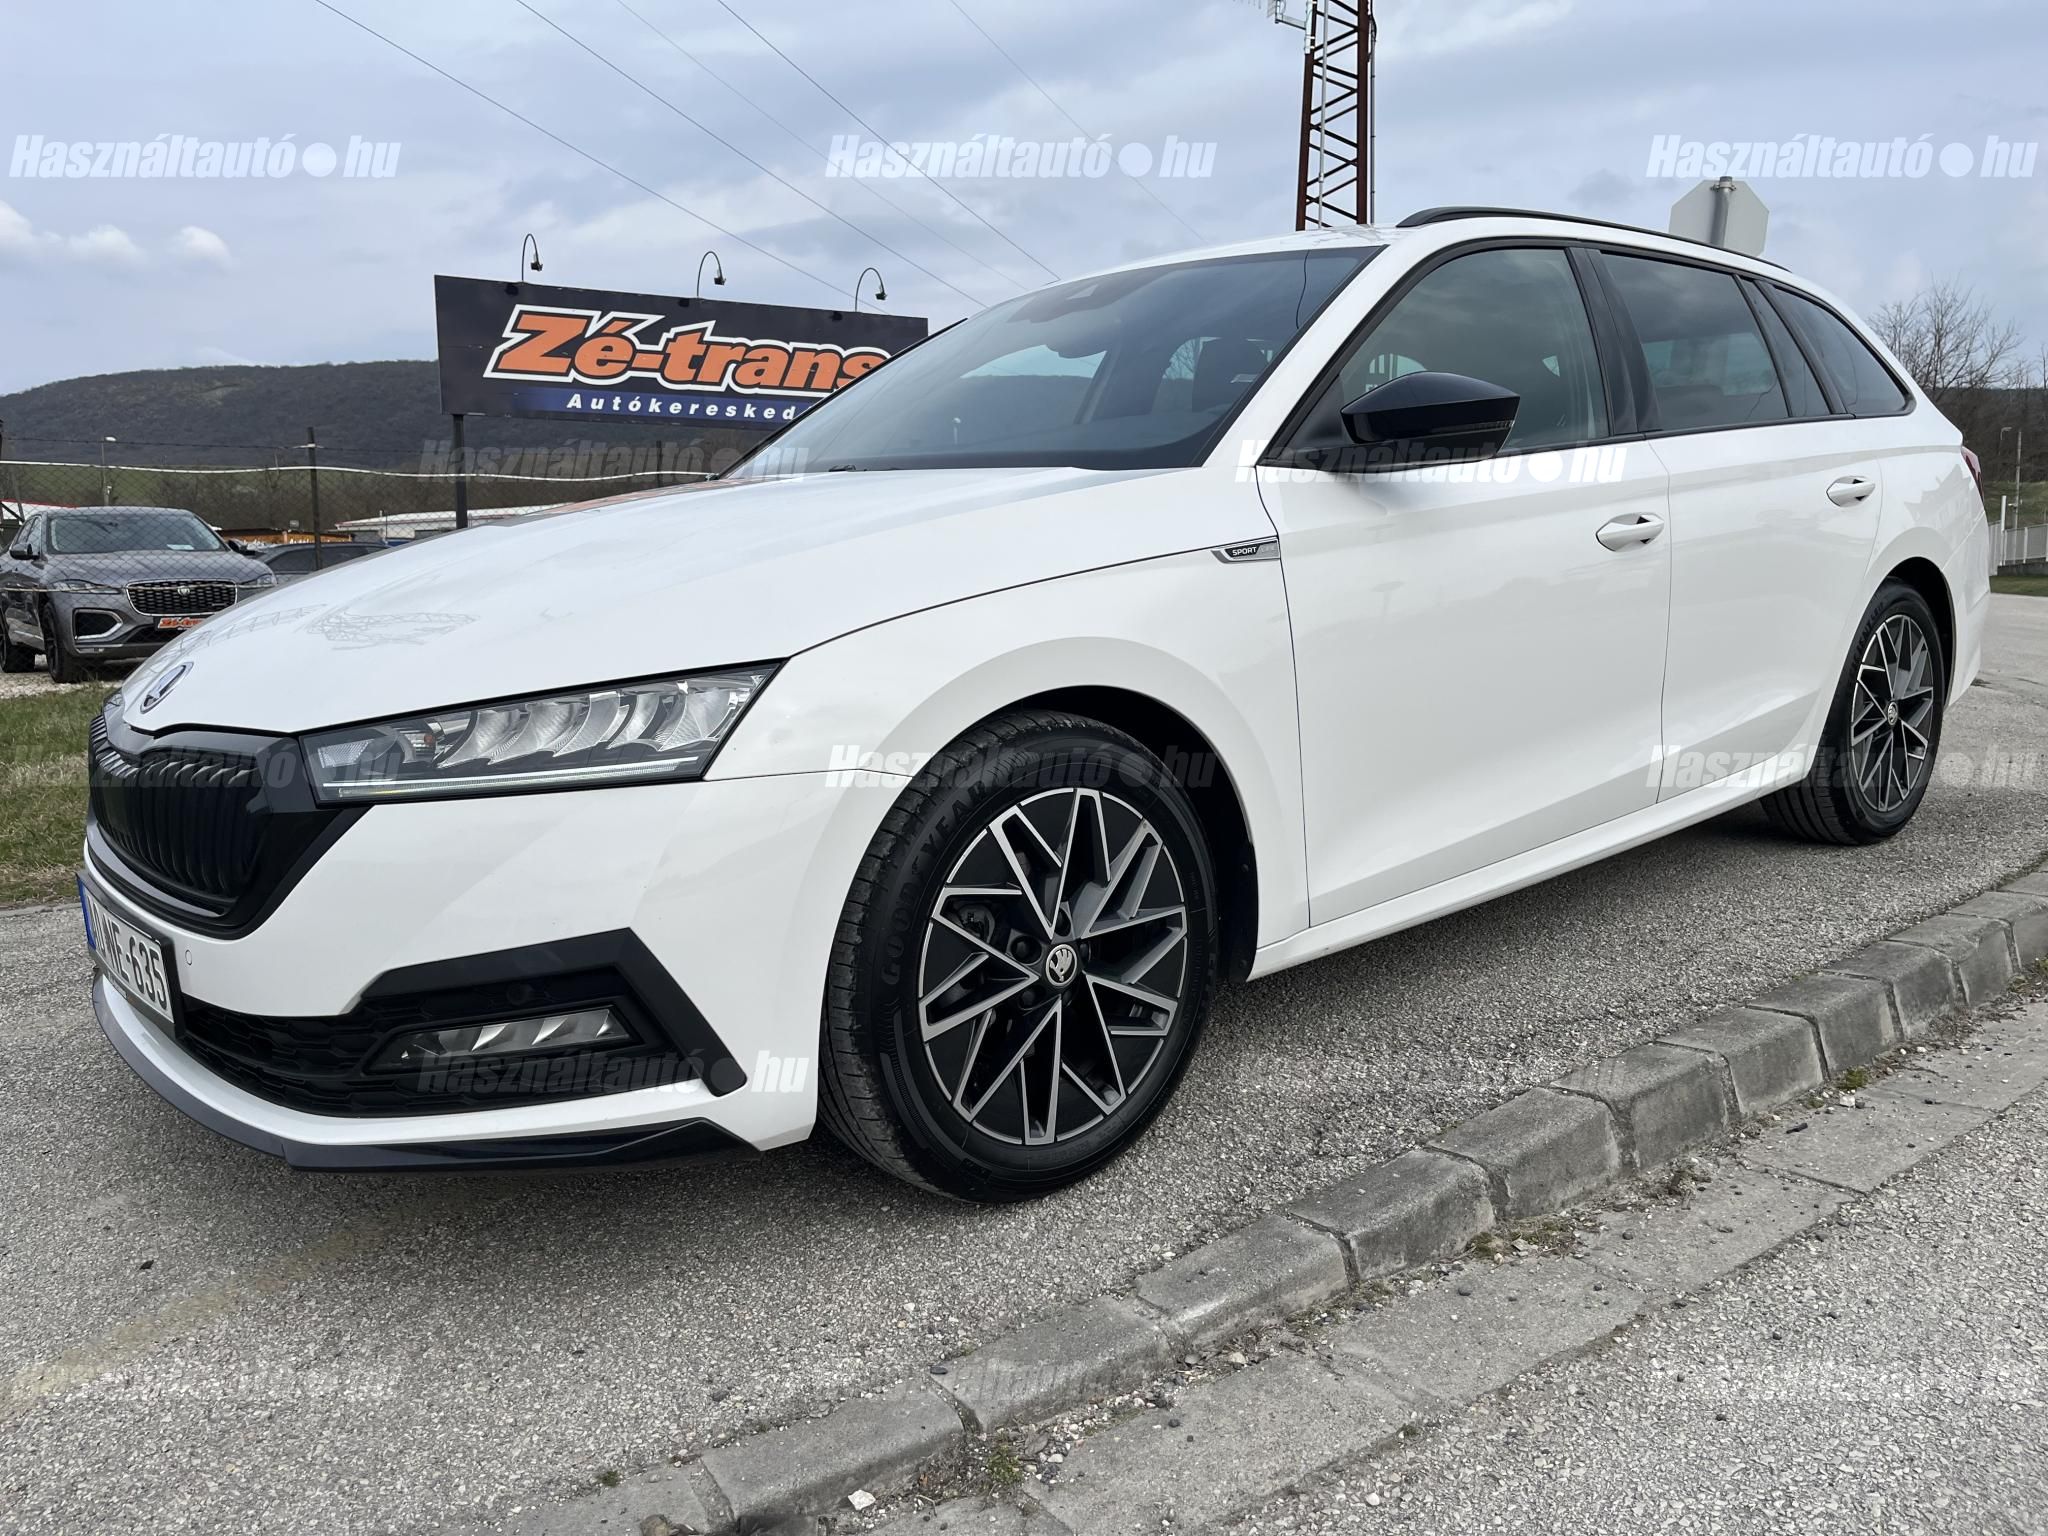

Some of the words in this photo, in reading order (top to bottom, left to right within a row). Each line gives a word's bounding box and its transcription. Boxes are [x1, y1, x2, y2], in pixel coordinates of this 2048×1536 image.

[487, 306, 892, 395] Zé-trans
[566, 393, 812, 421] Autókeresked
[1232, 546, 1257, 556] SPORT
